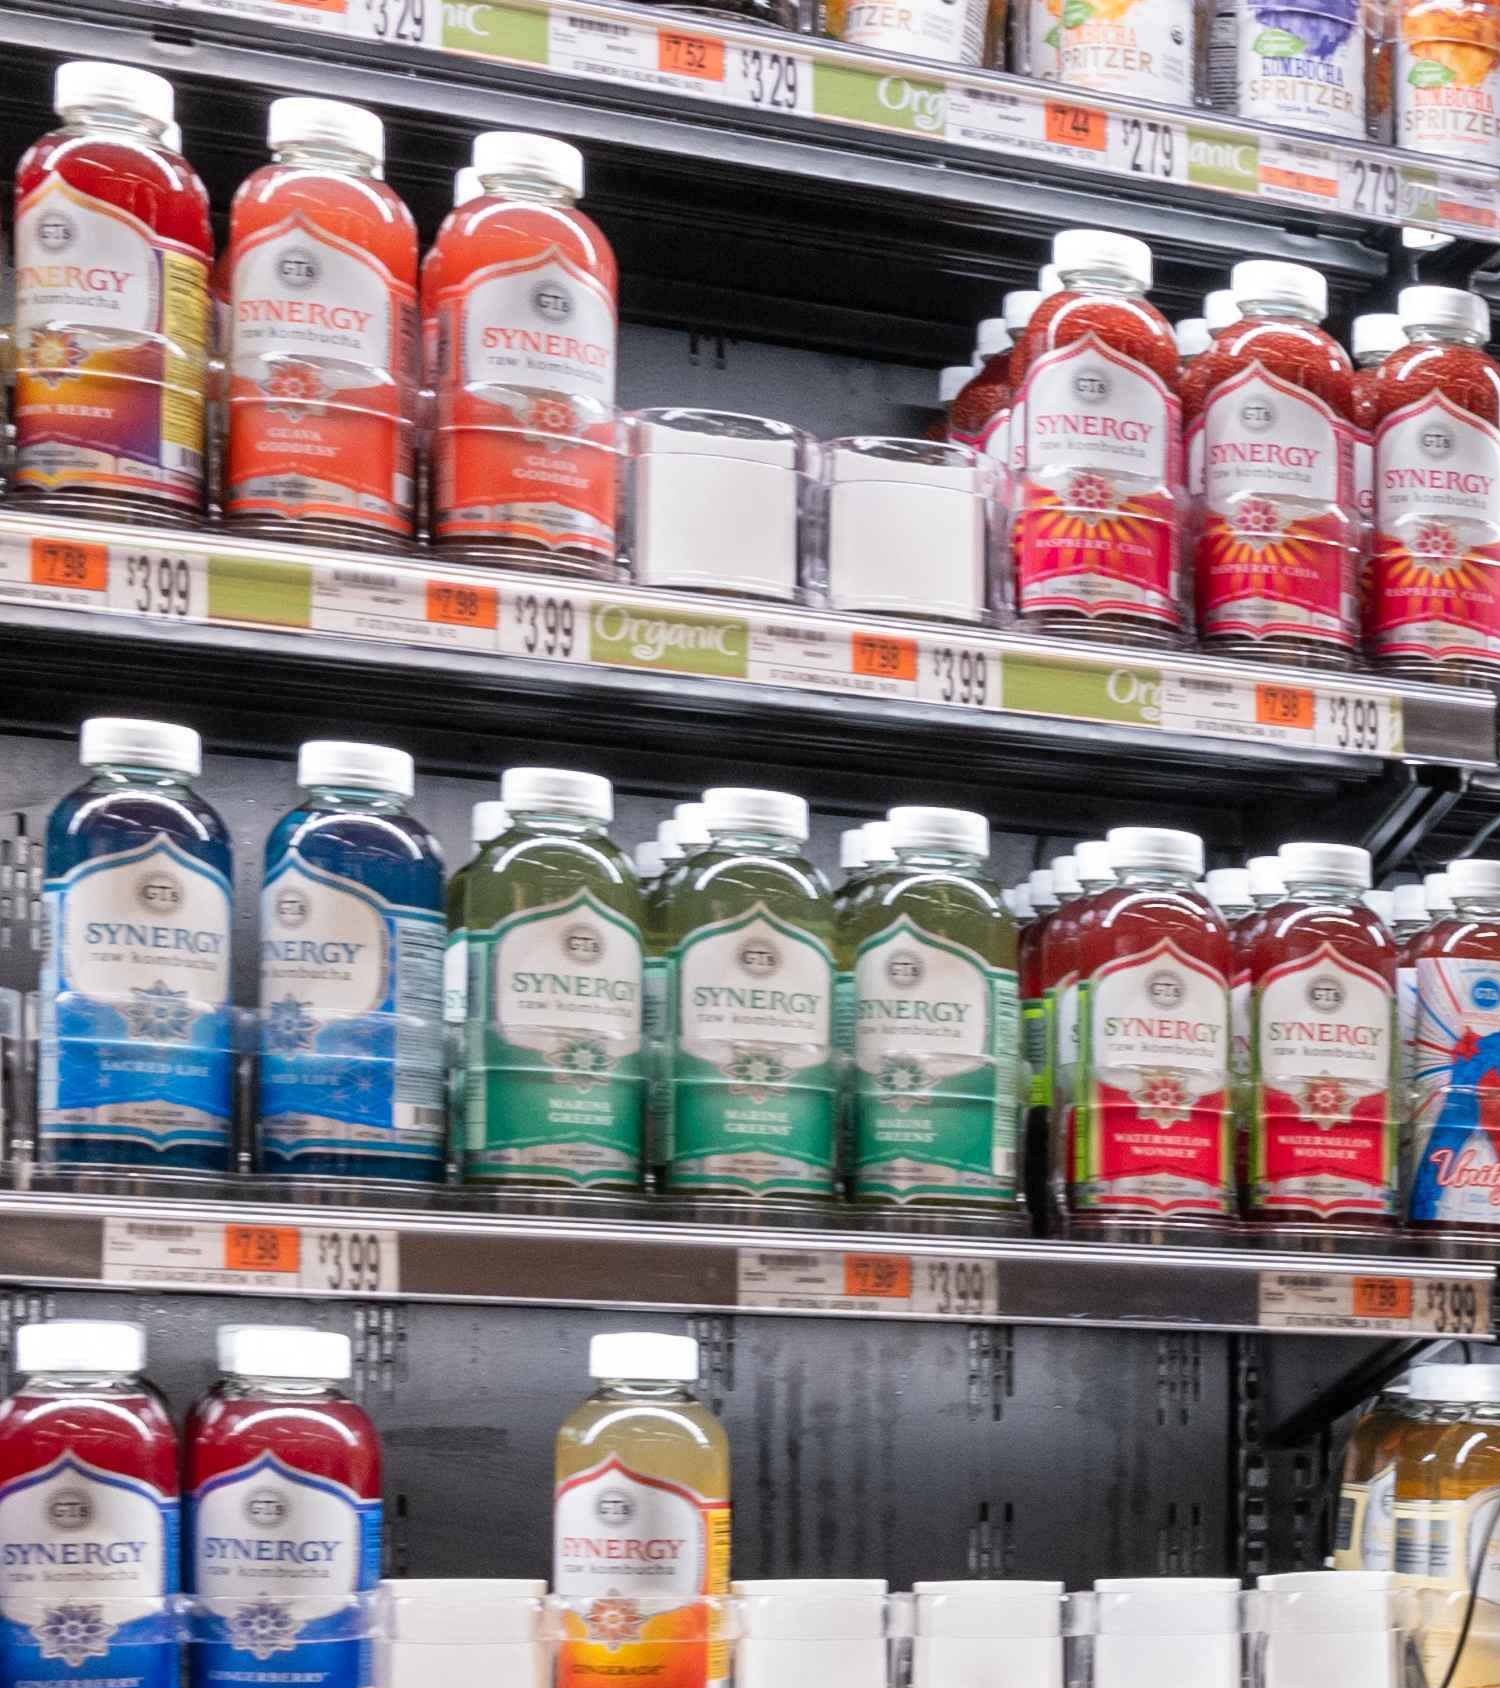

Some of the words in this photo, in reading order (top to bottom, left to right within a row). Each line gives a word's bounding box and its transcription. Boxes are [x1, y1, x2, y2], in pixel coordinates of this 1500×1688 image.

[1249, 76, 1356, 114] SPRITZER
[238, 298, 372, 334] SYNERGY
[1034, 412, 1152, 447] SYNERGY
[1209, 440, 1320, 470] SYNERGY
[1385, 468, 1495, 496] SYNERGY
[595, 605, 740, 662] Organic
[84, 920, 225, 957] SYNERGY
[511, 971, 641, 1002] SYNERGY
[692, 985, 823, 1016] SYNERGY
[1104, 1015, 1222, 1046] SYNERGY
[1268, 1020, 1384, 1050] SYNERGY
[4, 1539, 148, 1567] SYNERGY
[204, 1537, 342, 1564] SYNERGY
